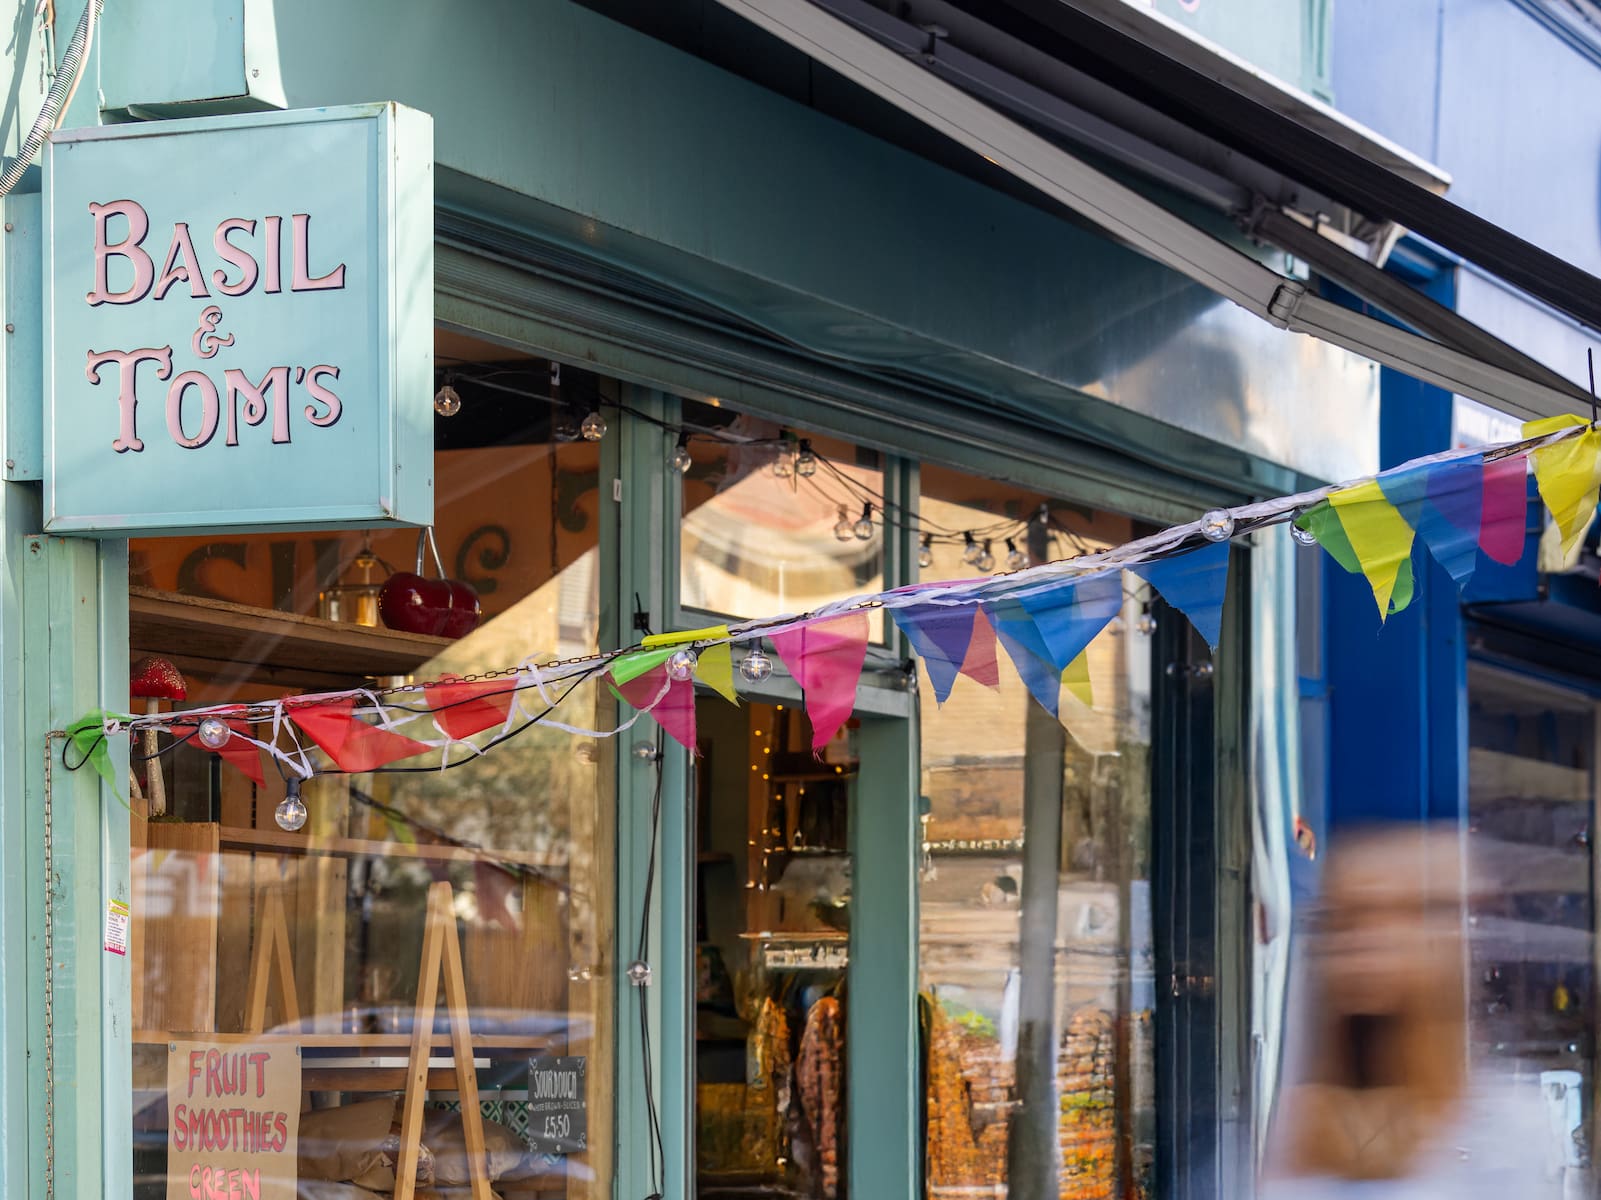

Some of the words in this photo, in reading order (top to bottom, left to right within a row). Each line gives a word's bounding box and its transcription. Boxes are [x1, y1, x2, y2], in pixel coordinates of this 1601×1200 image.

[86, 199, 346, 305] BASIL
[192, 305, 235, 359] &
[86, 345, 342, 453] TOM'S
[188, 1048, 271, 1098] FRUIT
[174, 1104, 287, 1153] SMOOTHIES
